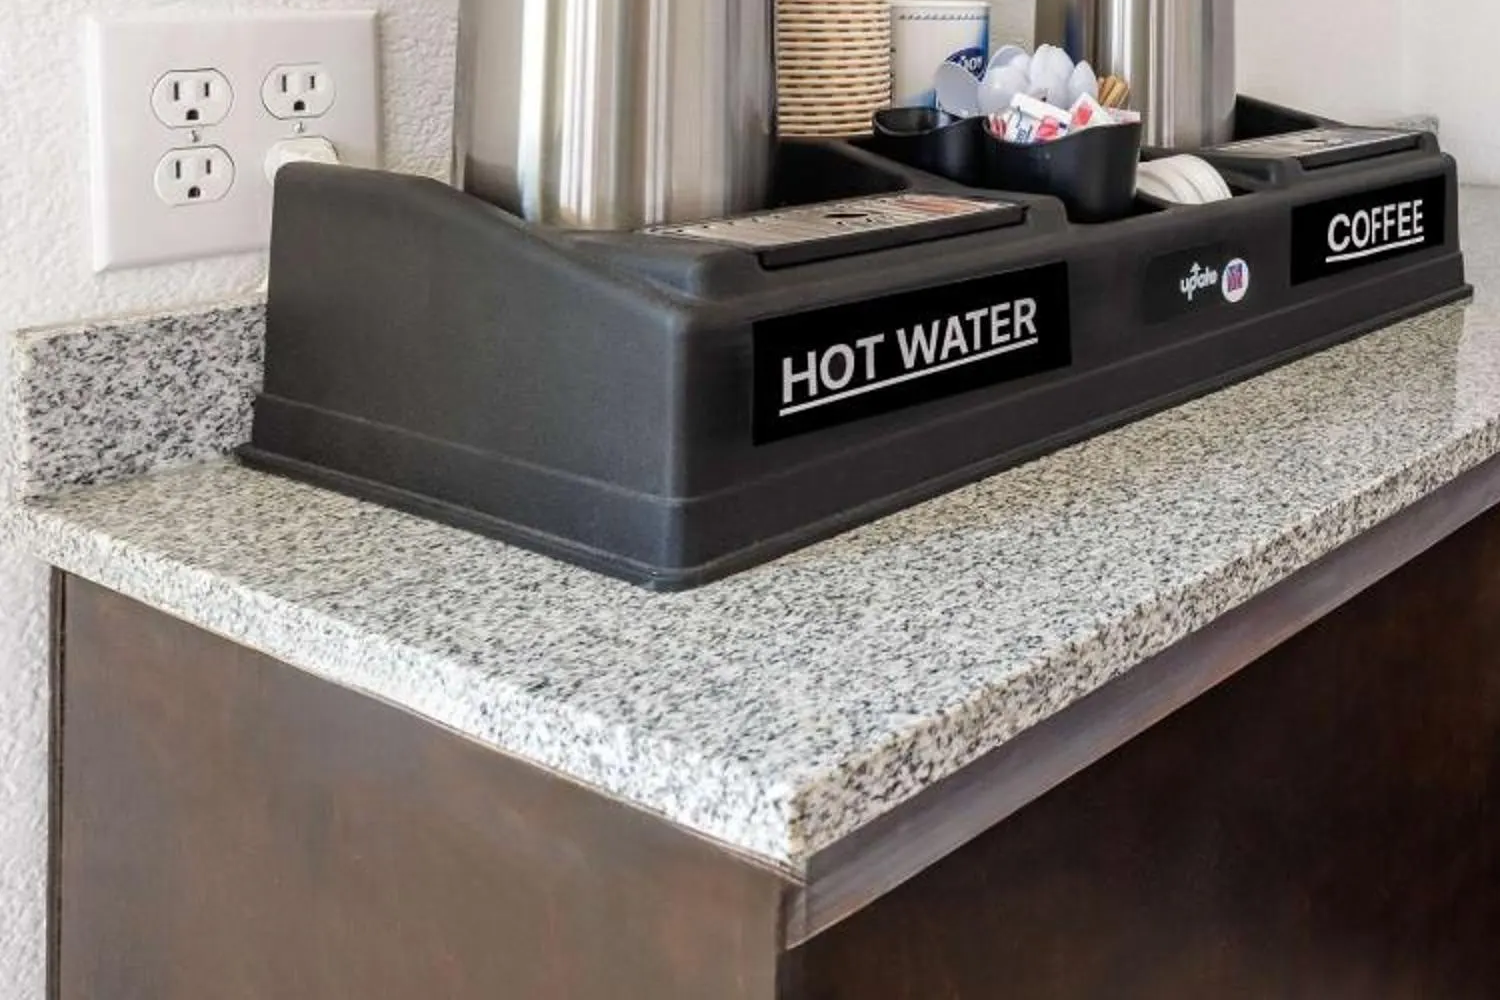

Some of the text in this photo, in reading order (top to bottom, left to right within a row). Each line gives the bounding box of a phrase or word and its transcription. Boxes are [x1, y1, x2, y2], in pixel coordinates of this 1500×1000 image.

[1327, 199, 1424, 252] COFFEE
[781, 298, 1038, 404] HOT WATER
